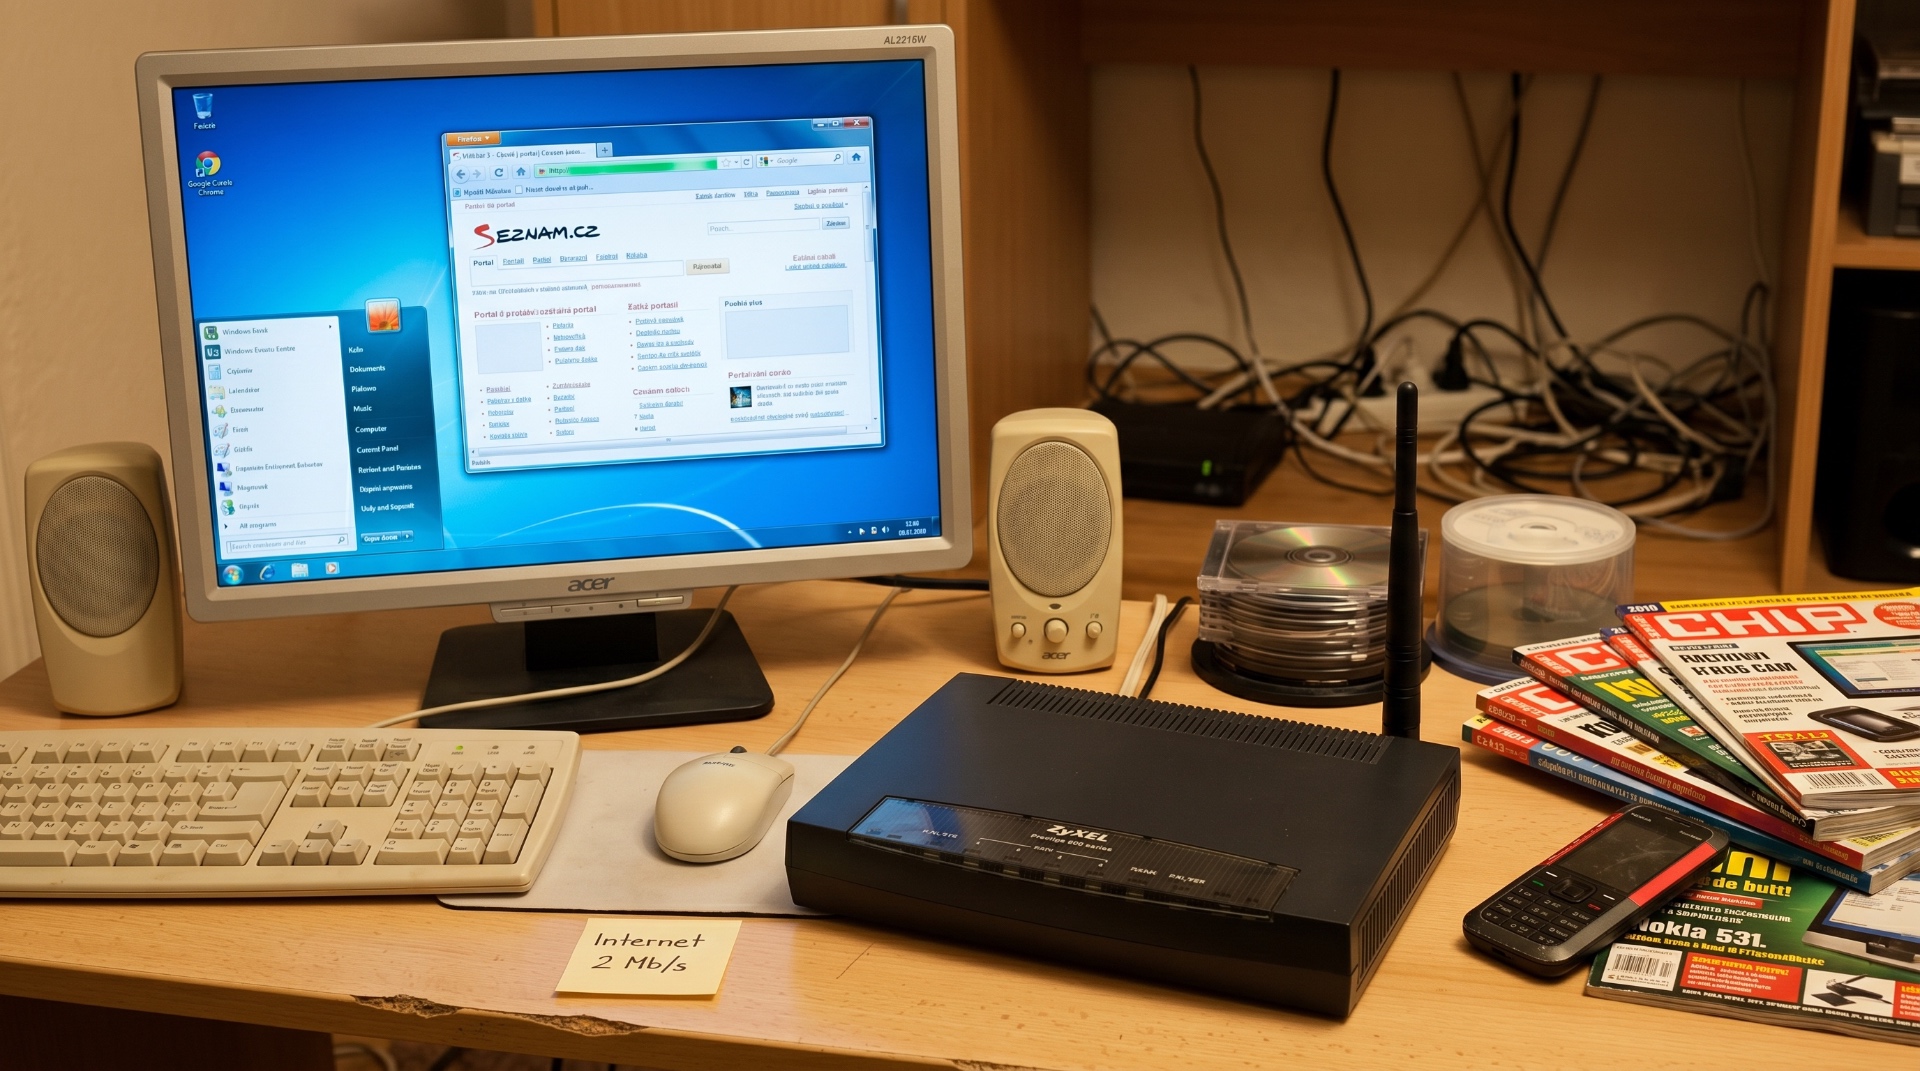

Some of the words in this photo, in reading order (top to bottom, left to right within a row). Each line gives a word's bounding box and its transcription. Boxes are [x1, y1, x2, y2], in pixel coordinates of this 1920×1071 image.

[188, 180, 210, 188] Google
[198, 188, 224, 196] Chrome
[473, 224, 600, 250] SEZNAM.CZ
[223, 328, 251, 336] Windows
[224, 347, 253, 355] Windows
[349, 365, 386, 373] Dokuments
[355, 425, 387, 434] Computer
[567, 577, 615, 592] acer
[1627, 604, 1658, 613] 2010
[1653, 605, 1857, 638] CHIP
[1042, 652, 1071, 660] acer
[1751, 662, 1798, 673] CAM
[1046, 824, 1109, 843] ZyXEL
[1712, 877, 1738, 890] de
[1743, 880, 1792, 898] butt!
[594, 933, 706, 948] Internet
[591, 955, 613, 969] 2
[624, 955, 687, 974] Mb/s
